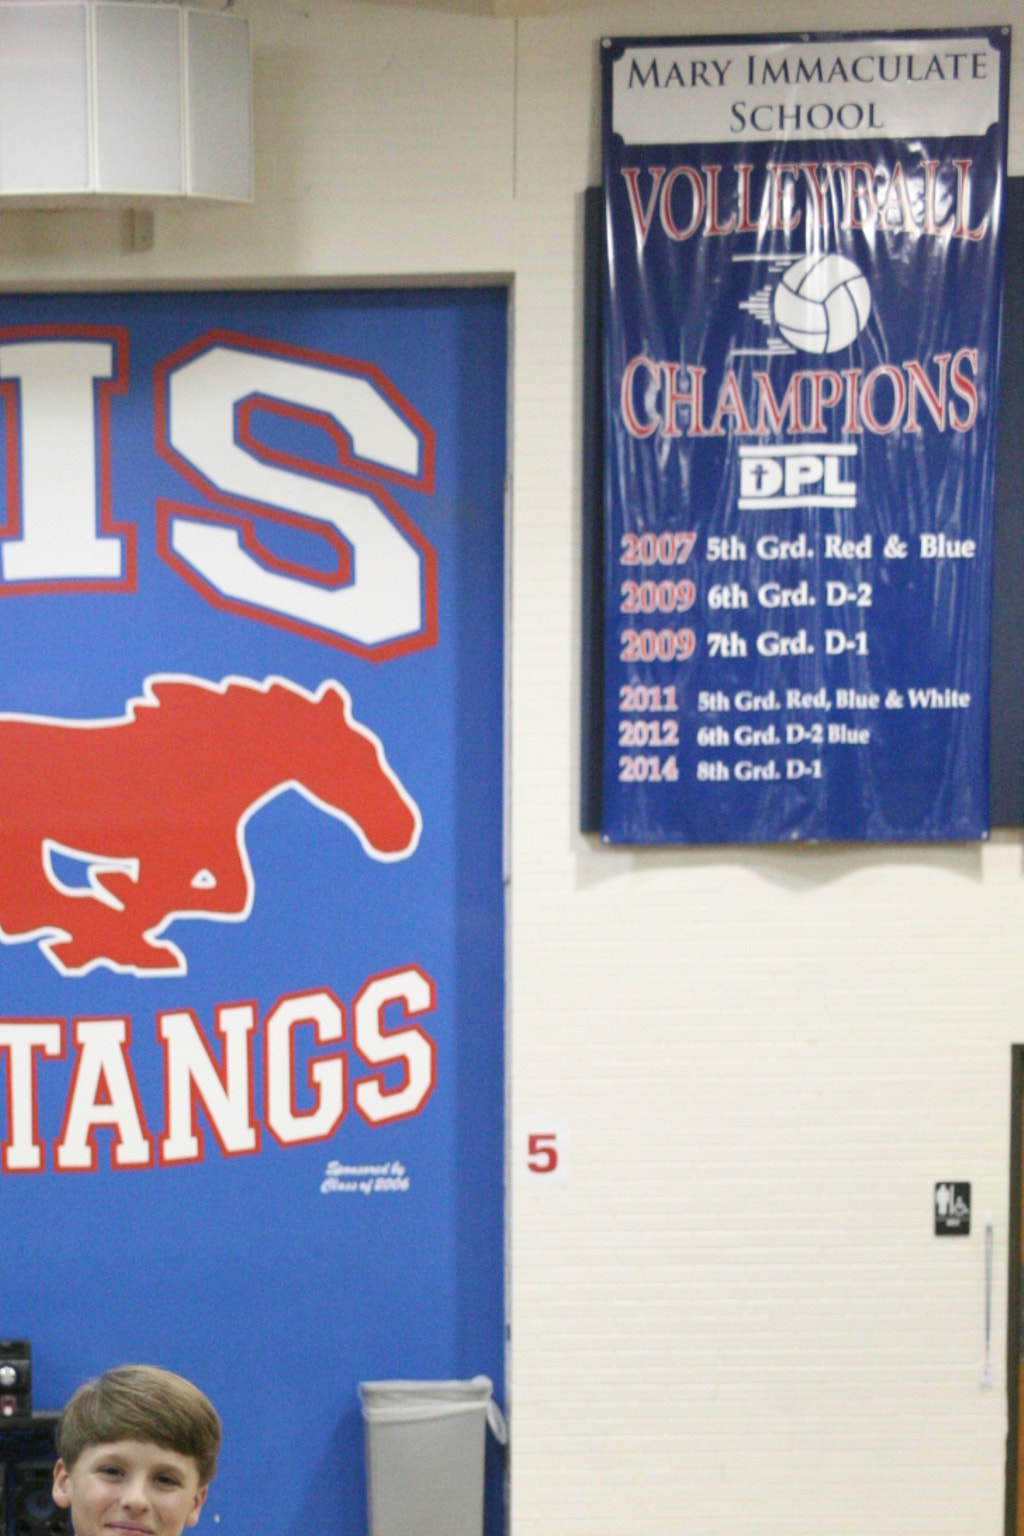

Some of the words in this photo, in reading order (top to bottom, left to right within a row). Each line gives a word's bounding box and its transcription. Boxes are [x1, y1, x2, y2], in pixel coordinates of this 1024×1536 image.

[627, 57, 733, 89] MARY
[747, 53, 988, 86] IMMACULATE
[729, 102, 885, 133] SCHOOL
[621, 160, 988, 241] VOLLEYBALL
[621, 348, 979, 439] CHAMPIONS
[740, 457, 857, 497] DPL
[620, 532, 696, 566] 2007
[706, 536, 747, 561] 5th
[756, 535, 815, 560] Grd.
[825, 534, 872, 559] Red
[883, 535, 908, 558] &
[919, 534, 976, 559] Blue
[620, 580, 696, 613] 2009
[707, 584, 748, 609] 6th
[757, 582, 816, 608] Grd.
[825, 582, 872, 607] D-2
[620, 629, 696, 662] 2009
[707, 632, 748, 657] 7th
[756, 630, 815, 656] Grd.
[825, 631, 870, 655] D-1
[619, 687, 678, 712] 2011
[697, 691, 730, 712] 5th
[734, 690, 781, 711] Grd.
[786, 689, 831, 712] Red,
[835, 689, 880, 708] Blue
[884, 690, 905, 708] &
[907, 688, 971, 708] White
[619, 721, 678, 746] 2012
[697, 726, 730, 746] 6th
[734, 725, 780, 746] Grd.
[786, 724, 824, 745] D-2
[828, 724, 870, 745] Blue
[618, 756, 678, 782] 2014
[697, 761, 729, 781] 8th
[734, 760, 780, 780] Grd.
[786, 759, 823, 779] D-1
[528, 1133, 558, 1173] 5
